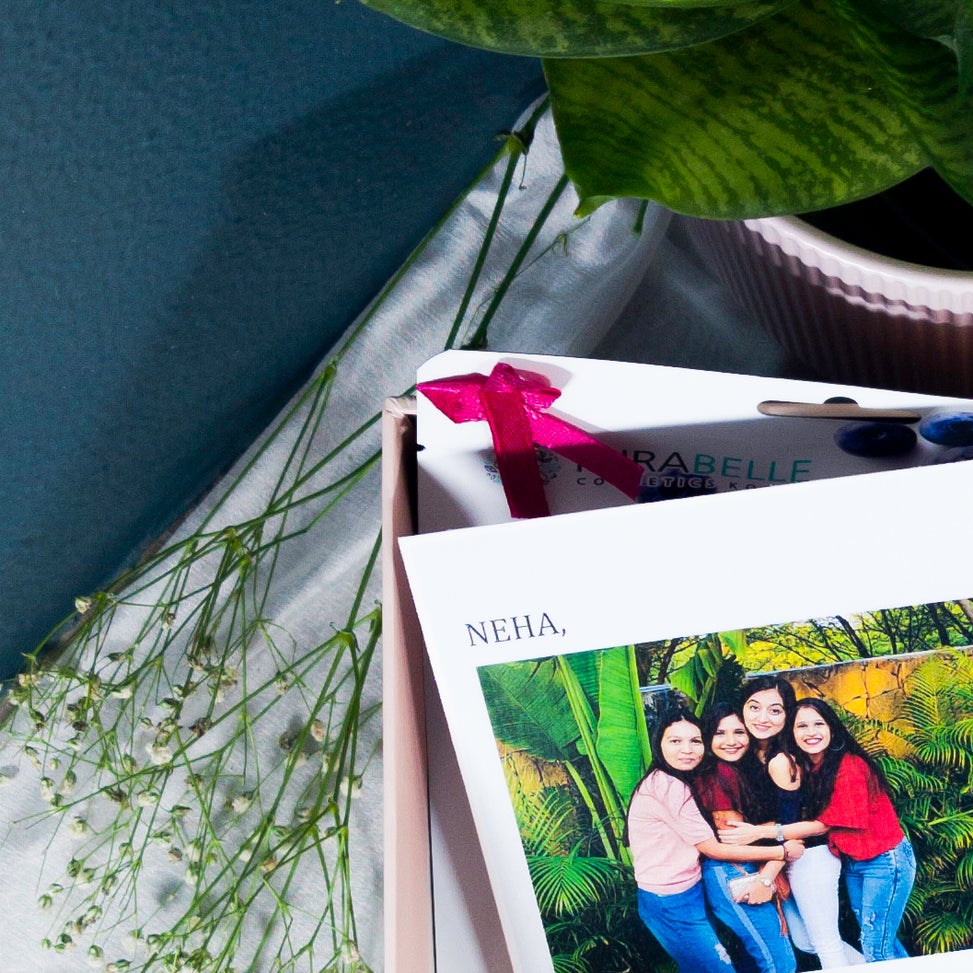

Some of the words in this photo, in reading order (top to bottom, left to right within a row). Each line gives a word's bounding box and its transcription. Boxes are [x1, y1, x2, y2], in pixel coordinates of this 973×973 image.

[577, 450, 812, 483] RABELLE
[577, 475, 716, 489] COETICS
[466, 612, 566, 646] NEHA,
